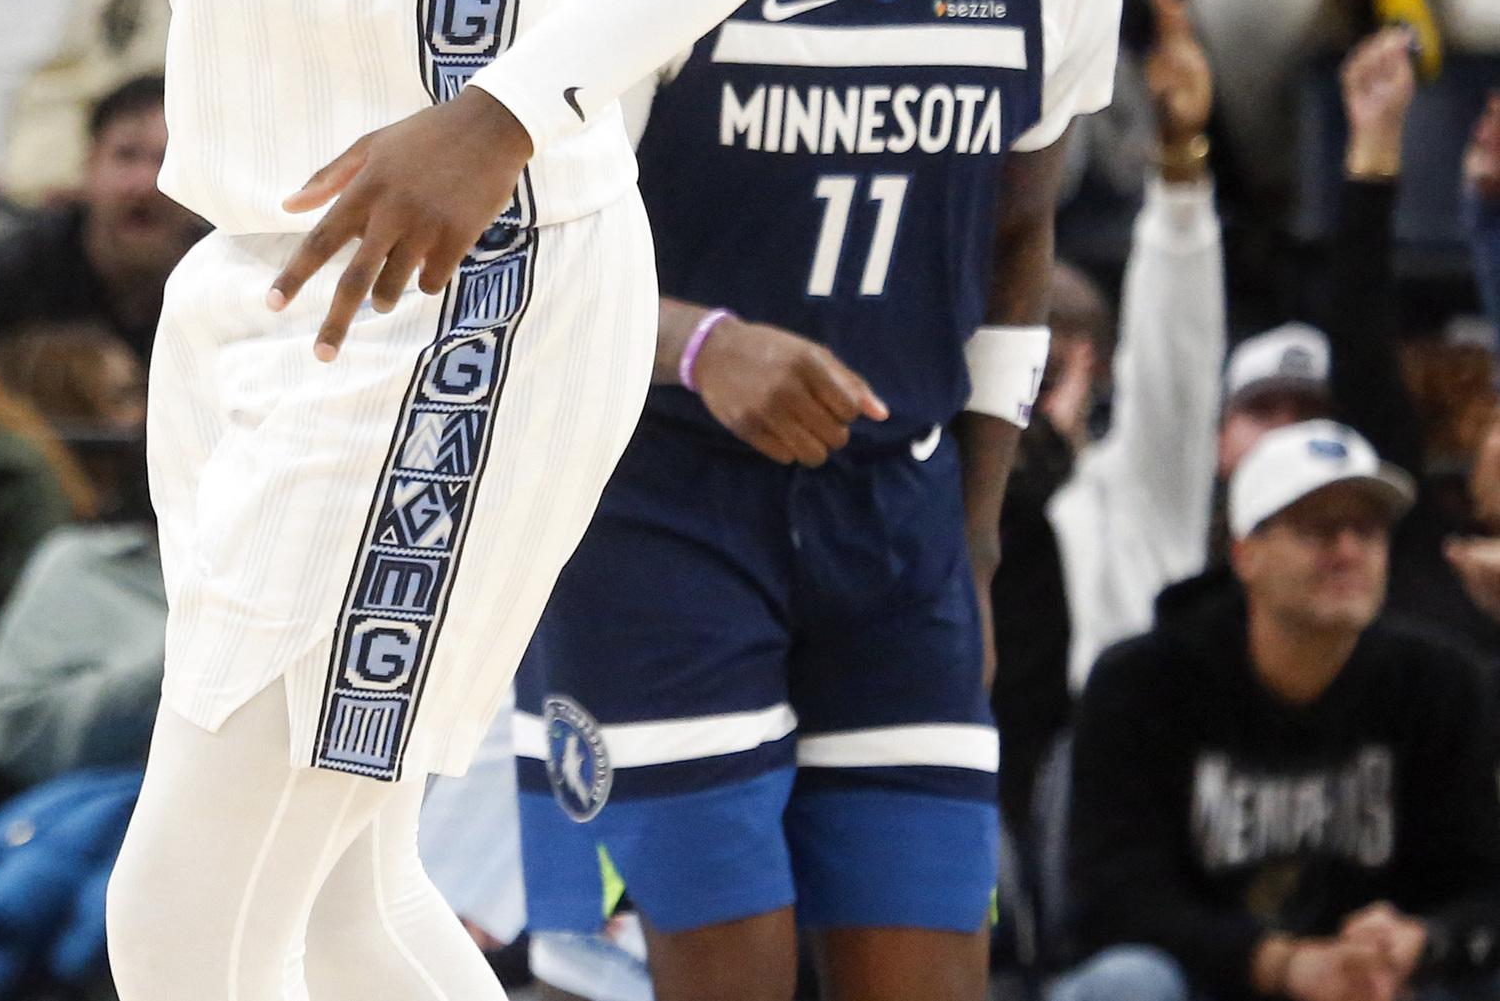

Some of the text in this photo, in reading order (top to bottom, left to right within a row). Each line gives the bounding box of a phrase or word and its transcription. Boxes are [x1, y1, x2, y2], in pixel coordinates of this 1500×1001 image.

[946, 0, 1007, 19] sezzle
[719, 83, 1002, 155] MINNESOTA
[807, 174, 908, 297] 11
